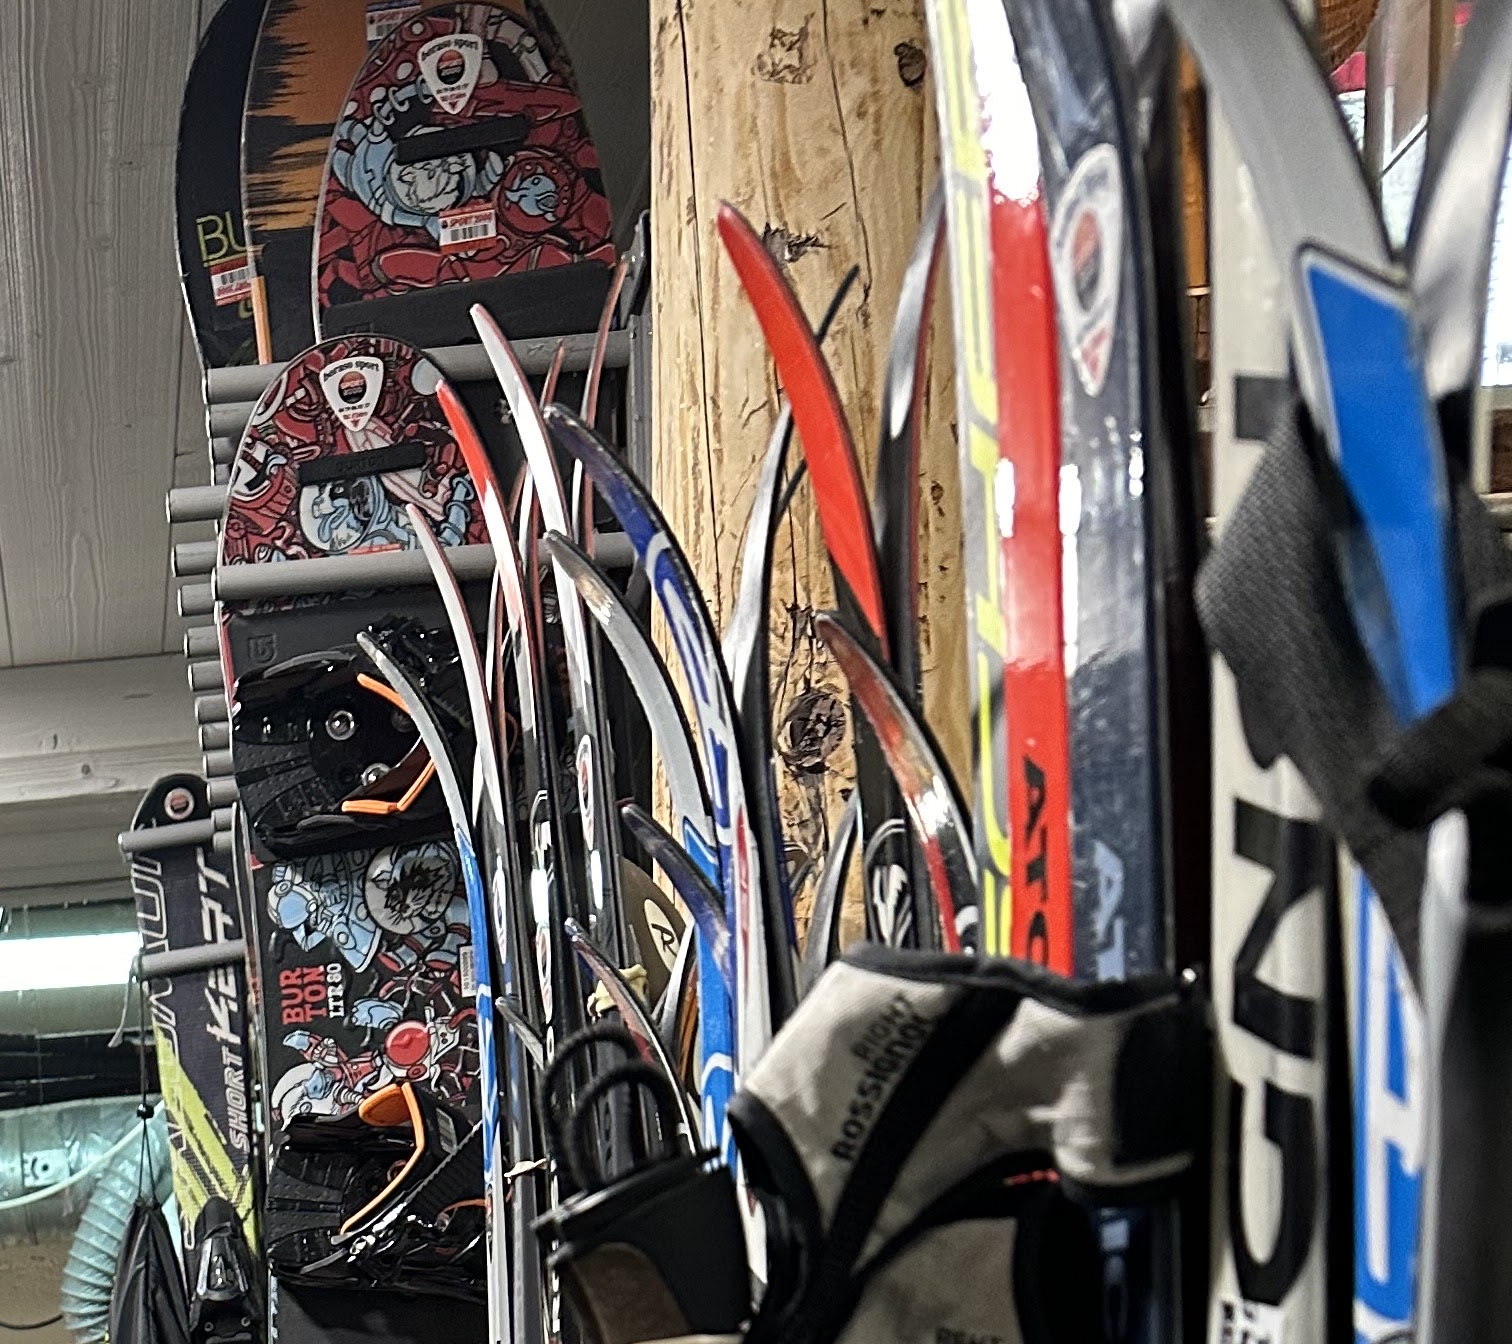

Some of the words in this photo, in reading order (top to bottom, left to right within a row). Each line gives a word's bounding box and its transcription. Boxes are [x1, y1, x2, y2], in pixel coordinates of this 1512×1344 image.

[278, 965, 305, 1026] BUR
[302, 963, 329, 1024] TON
[830, 1014, 932, 1162] ROSSIGNOL
